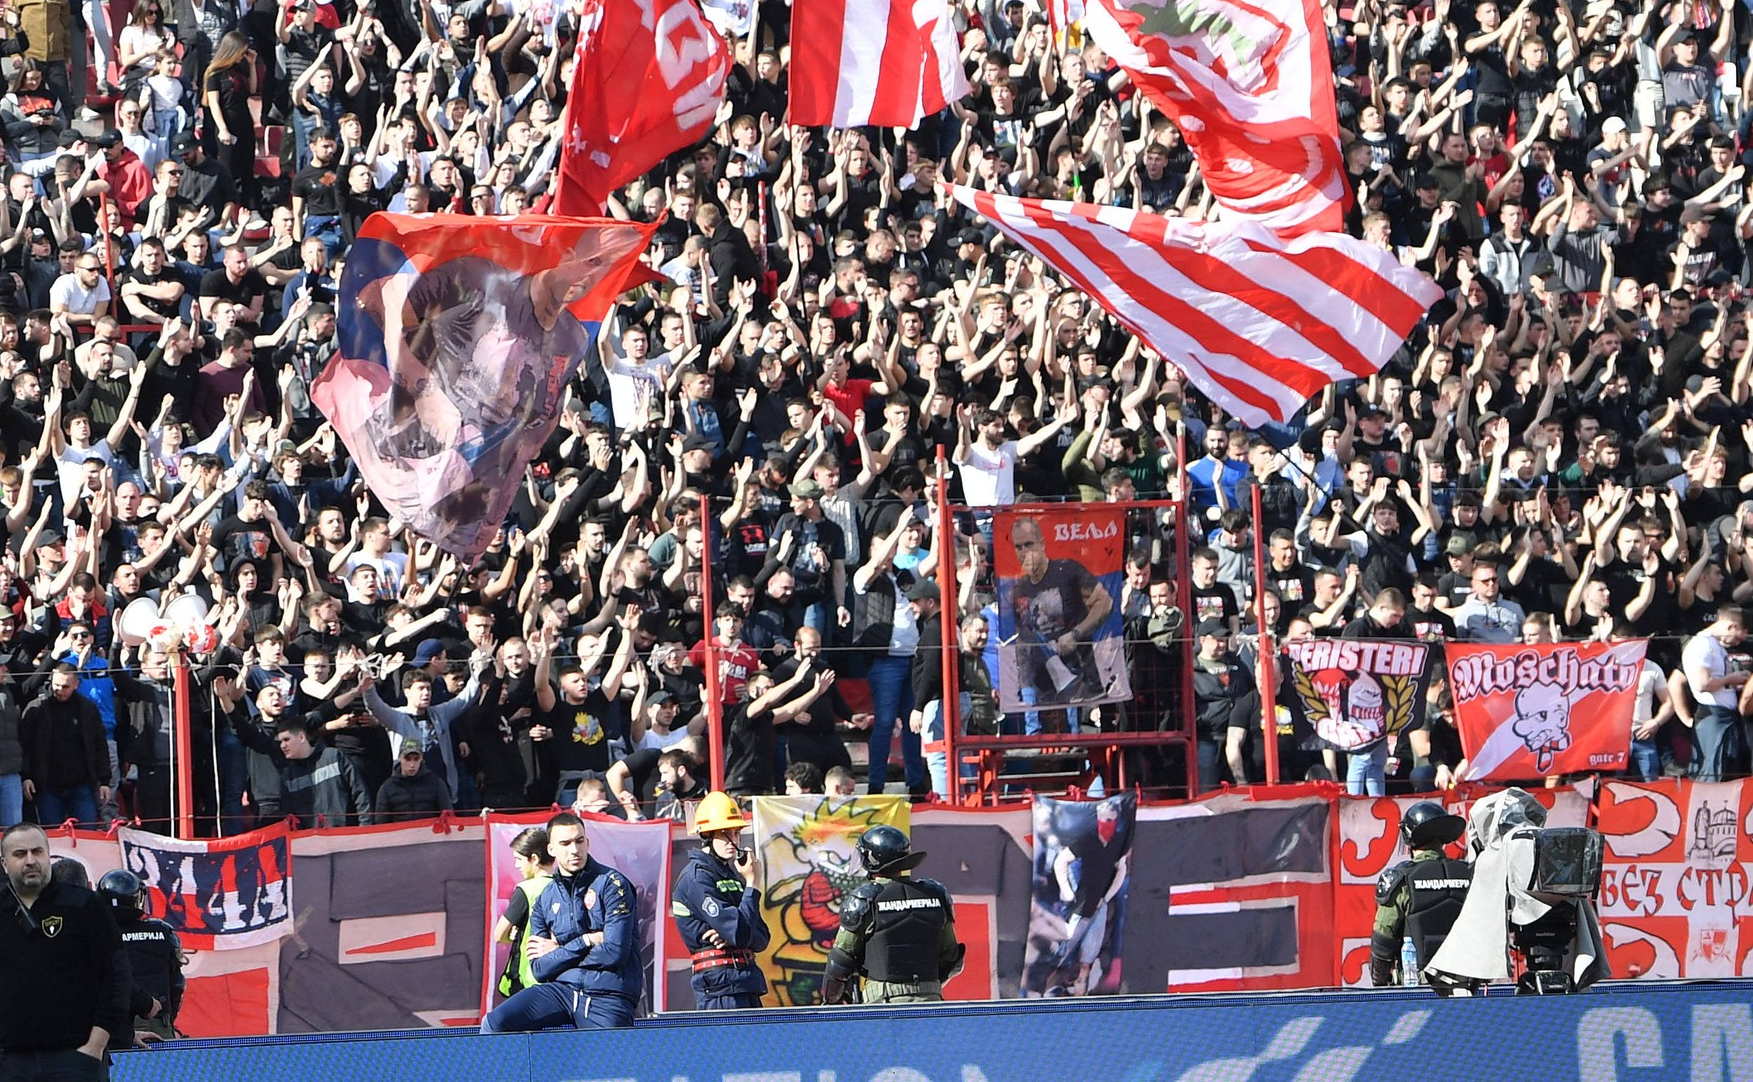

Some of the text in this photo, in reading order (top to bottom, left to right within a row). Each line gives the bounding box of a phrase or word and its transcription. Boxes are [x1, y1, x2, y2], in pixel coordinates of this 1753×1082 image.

[1288, 639, 1426, 676] PERISTERI
[1452, 647, 1641, 703] Moschato
[1589, 752, 1625, 767] gate 7
[1414, 879, 1470, 891] ЖАНДАРМЕРИ
[1600, 859, 1753, 928] БЕЗ СТР
[877, 898, 941, 911] ЖАНДАРМЕРИЈА
